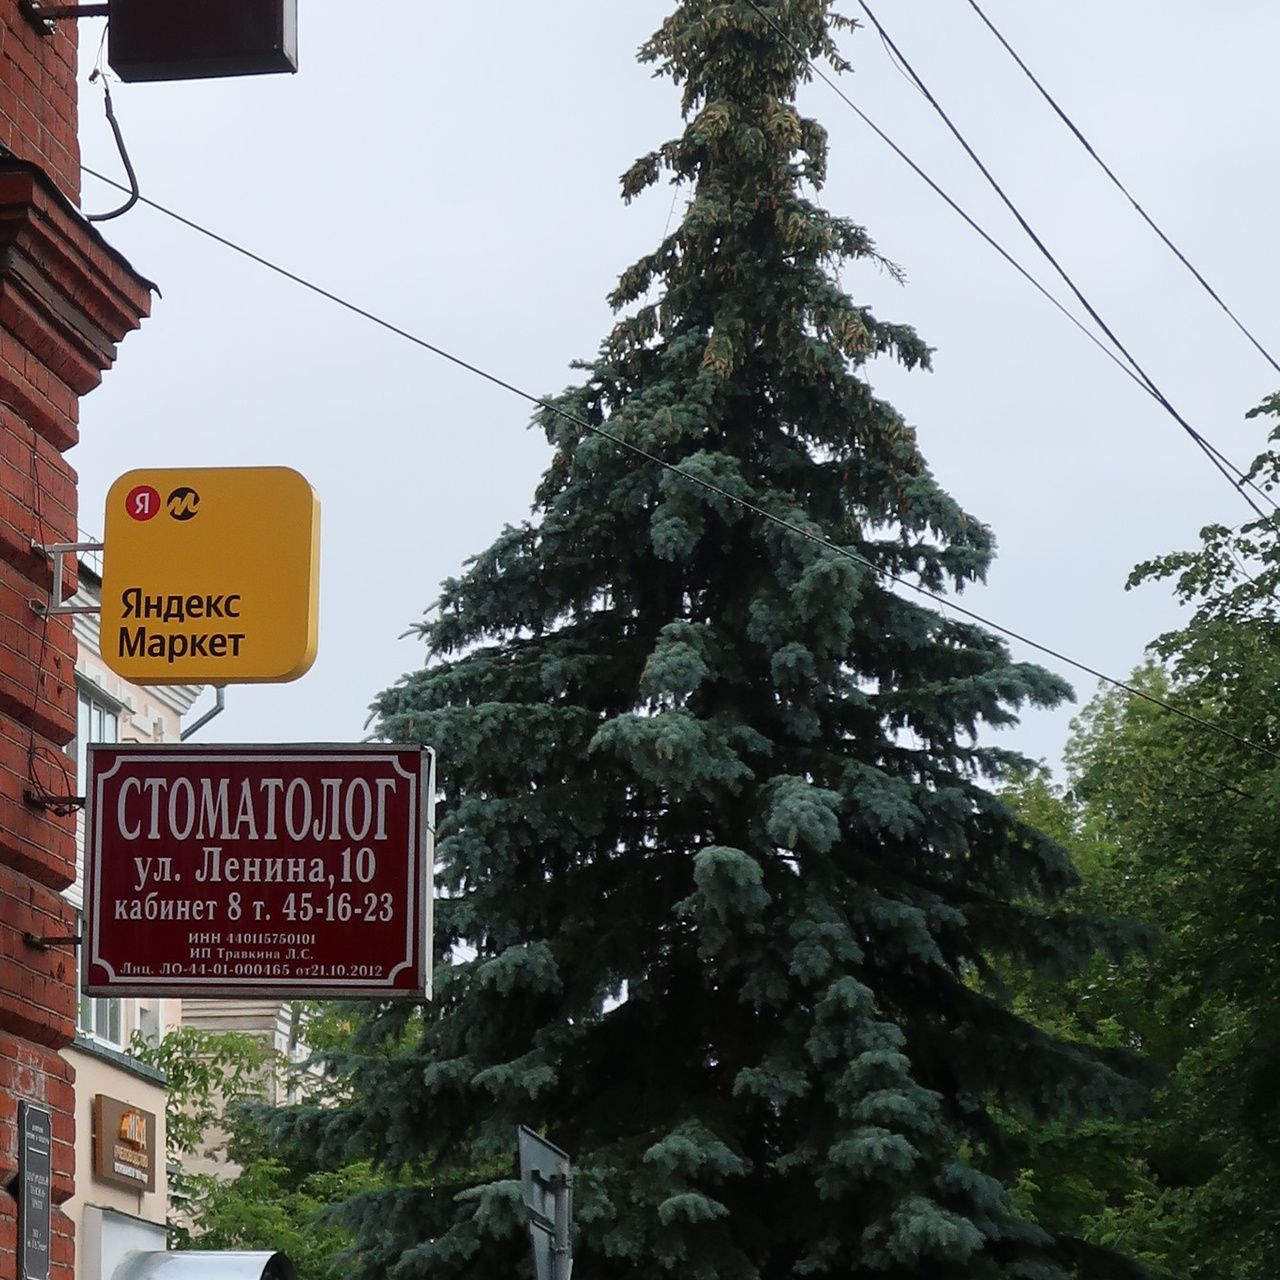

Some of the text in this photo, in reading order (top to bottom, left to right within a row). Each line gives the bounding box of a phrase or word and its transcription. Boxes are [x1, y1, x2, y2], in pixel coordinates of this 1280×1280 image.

[121, 587, 241, 622] Яндекс
[118, 626, 246, 664] Маркет
[116, 776, 397, 842] СТОМАТОЛОГ
[134, 856, 181, 892] ул.
[114, 891, 394, 922] кабинет 8 т. 45-16-23
[188, 932, 316, 945] ИНН 440115750101
[189, 947, 211, 959] ИП
[216, 948, 281, 962] Травкина
[120, 963, 154, 976] Лиц.
